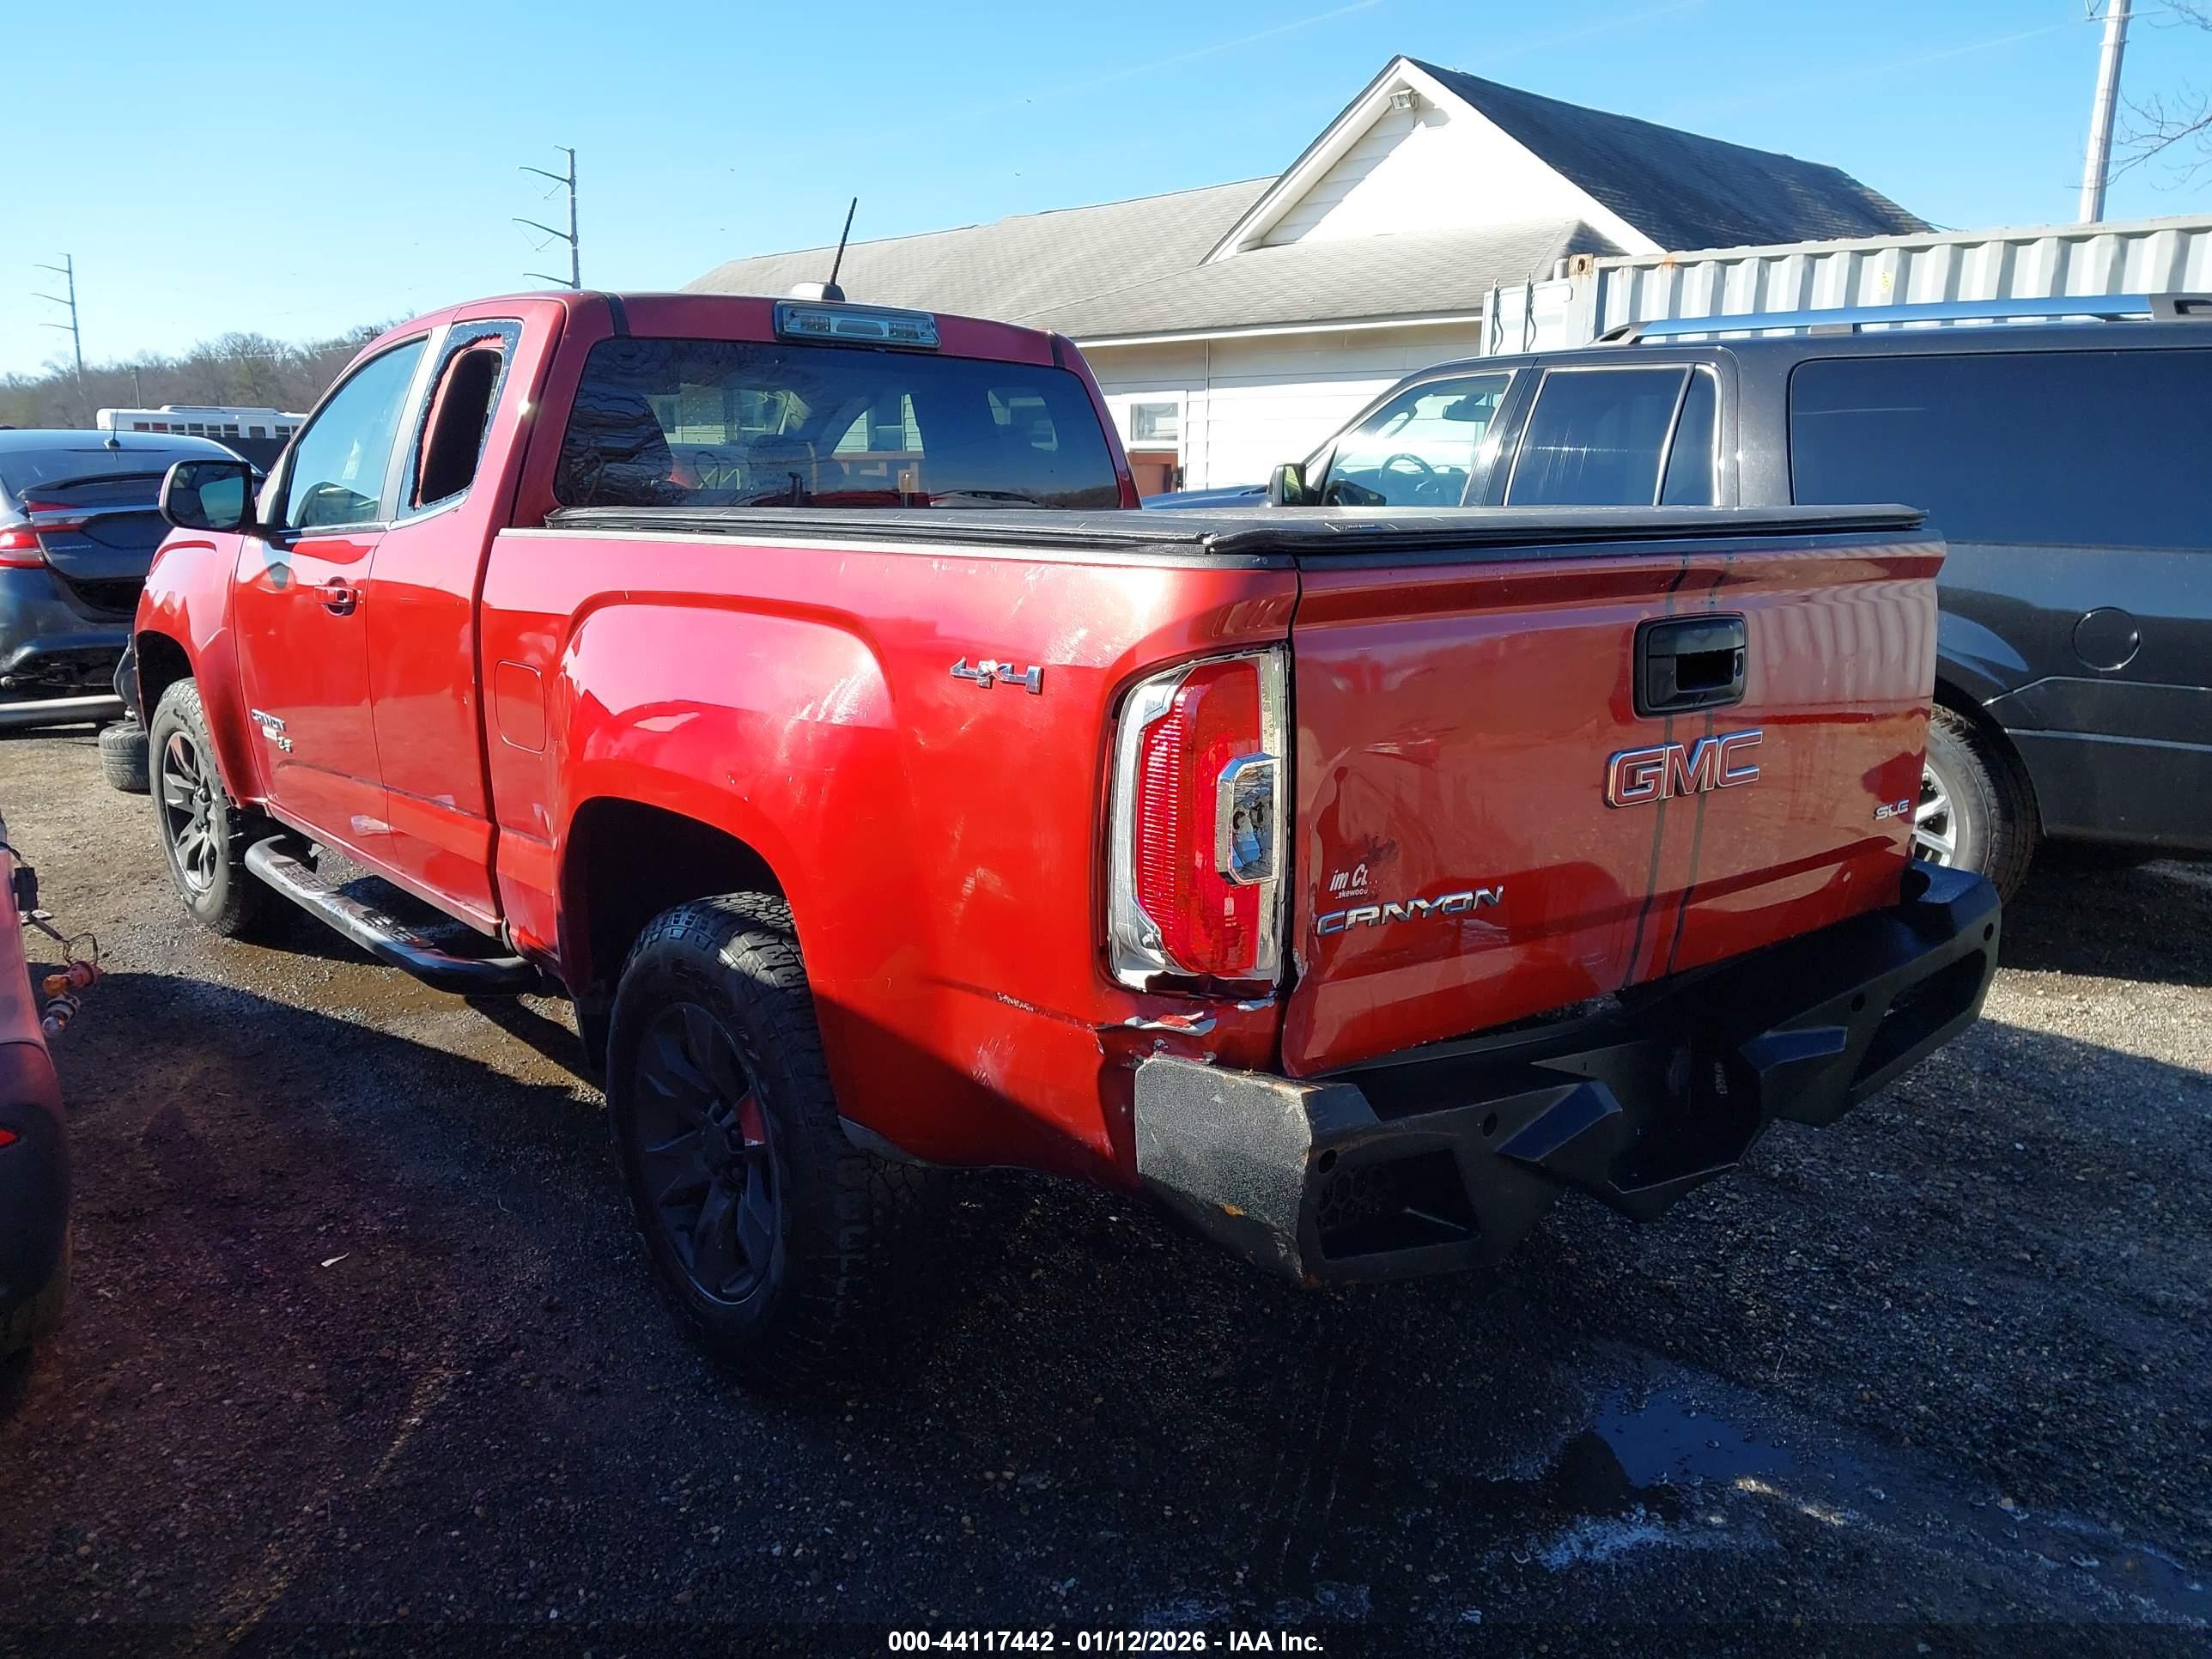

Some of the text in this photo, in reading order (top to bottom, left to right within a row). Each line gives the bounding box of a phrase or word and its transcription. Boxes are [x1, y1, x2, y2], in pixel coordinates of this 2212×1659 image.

[1602, 728, 1763, 809] GMC
[1874, 799, 1910, 821] SLE
[1317, 885, 1504, 937] CANYON
